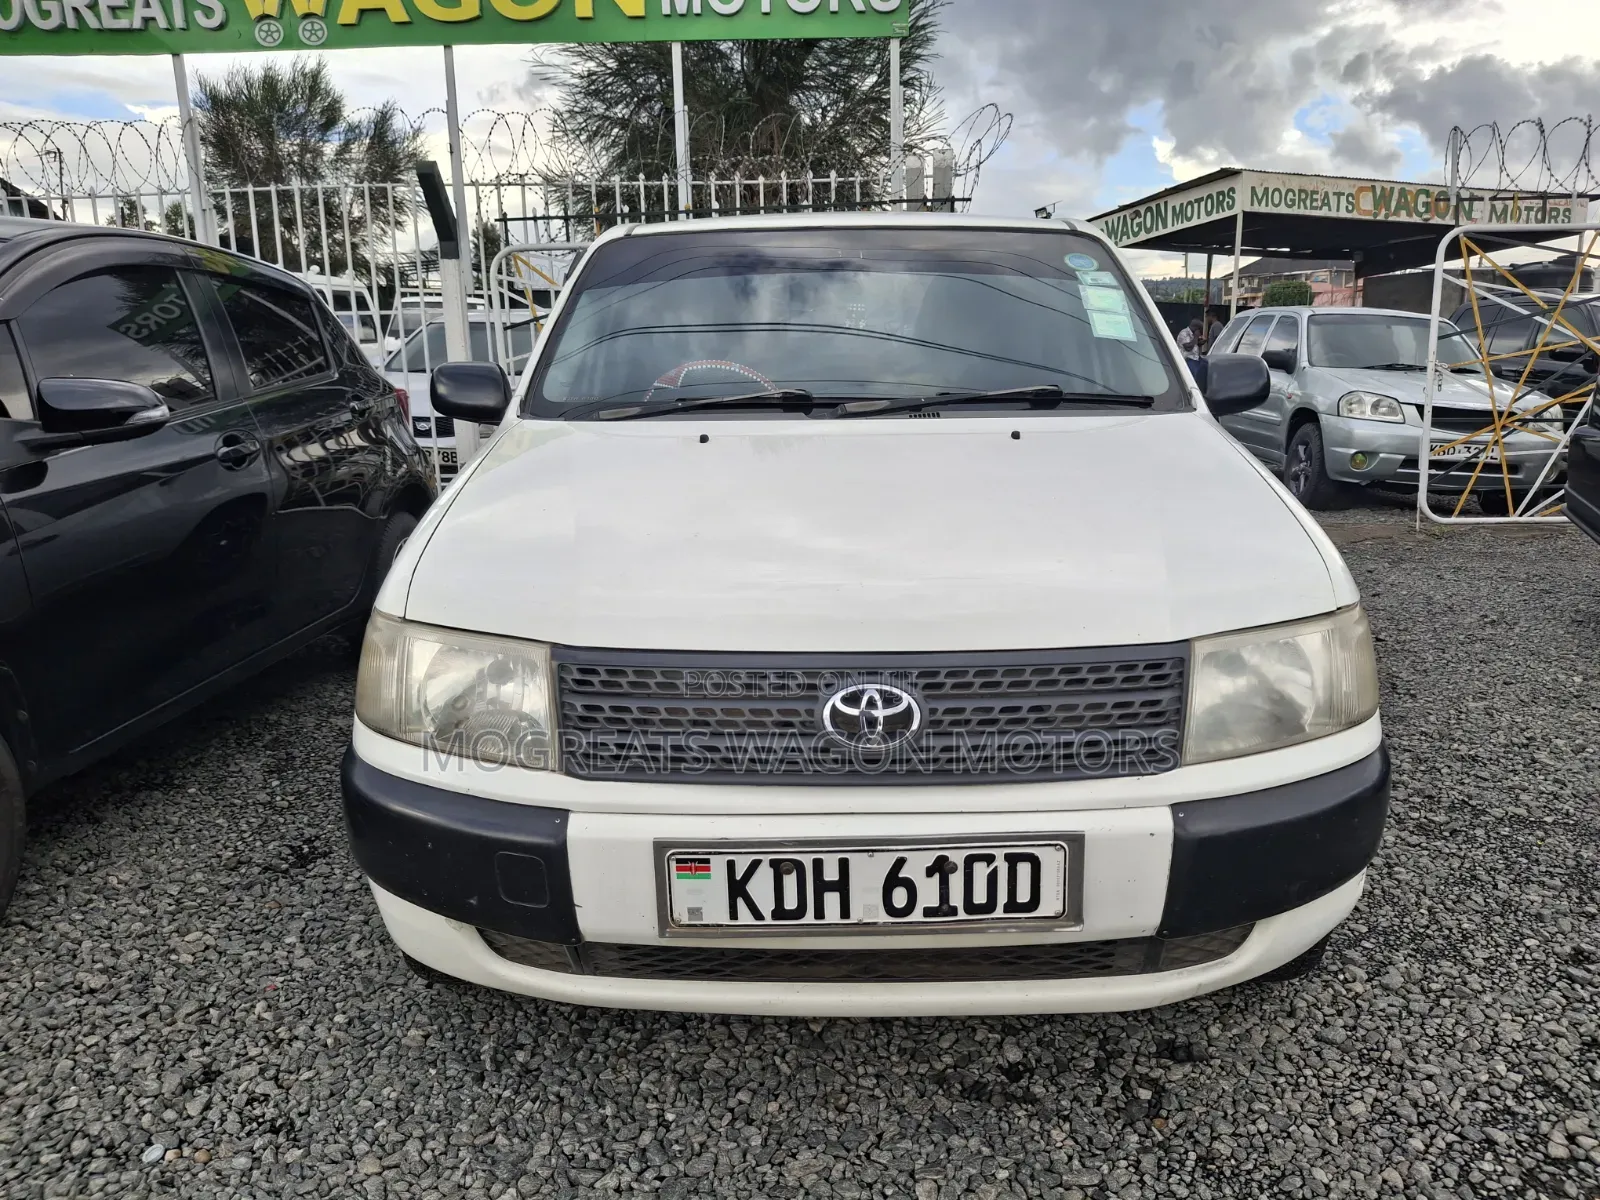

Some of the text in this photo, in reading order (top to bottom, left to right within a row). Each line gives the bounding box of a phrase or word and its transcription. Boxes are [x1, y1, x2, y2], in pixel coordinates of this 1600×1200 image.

[1104, 187, 1236, 243] WAGON MOTORS
[1250, 186, 1356, 214] MOGREATS
[725, 856, 851, 921] KDH
[881, 852, 1041, 918] 610D
